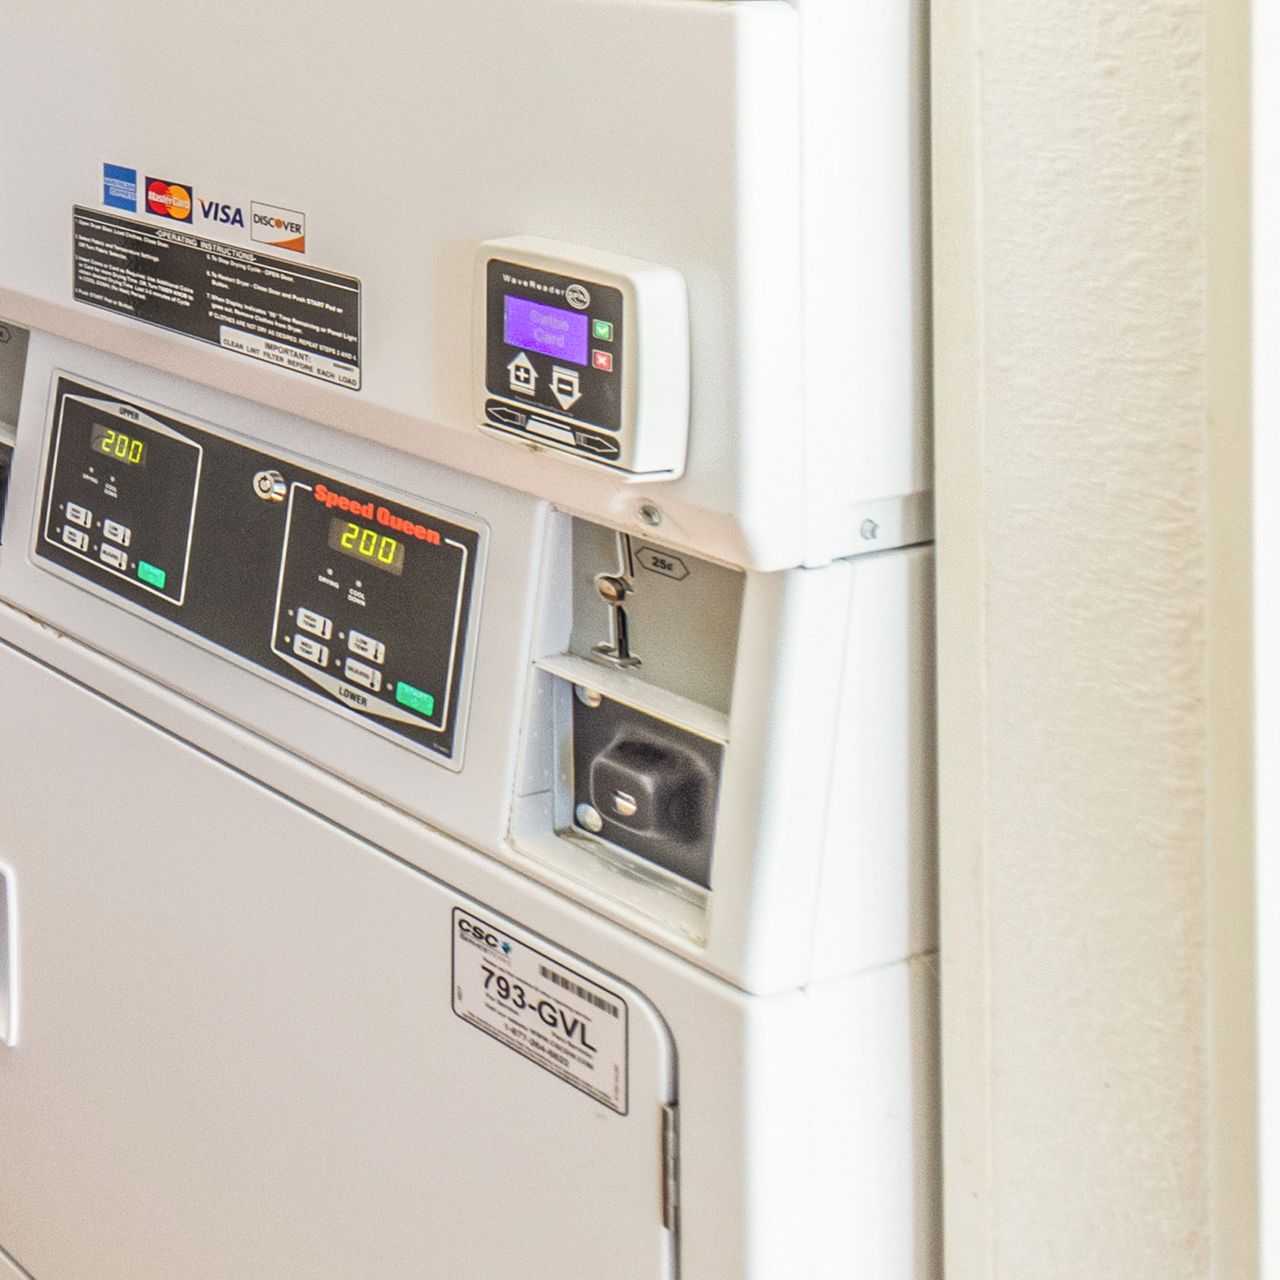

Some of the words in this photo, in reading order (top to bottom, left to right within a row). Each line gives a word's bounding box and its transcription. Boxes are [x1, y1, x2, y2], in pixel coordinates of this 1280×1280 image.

[148, 191, 190, 209] MasterCard
[197, 197, 245, 228] VISA
[253, 213, 302, 234] DISCOVER
[502, 273, 566, 296] WaveReader
[223, 337, 243, 350] CLEAN
[246, 345, 260, 355] LINT
[263, 350, 283, 363] FILTER
[287, 357, 312, 372] BEFORE
[316, 366, 334, 379] EACH
[338, 373, 356, 386] LOAD
[264, 341, 311, 363] IMPORTANT:
[119, 407, 139, 420] UPPER
[101, 430, 144, 463] 200
[313, 484, 375, 521] Speed
[376, 504, 442, 546] Queen
[341, 523, 397, 564] 200
[651, 555, 673, 572] 25¢
[317, 574, 339, 589] DRYING
[347, 593, 366, 607] DOWN
[348, 587, 366, 600] COOL
[339, 686, 368, 708] LOWER
[458, 918, 498, 948] CSC
[481, 964, 597, 1053] 793-GVL
